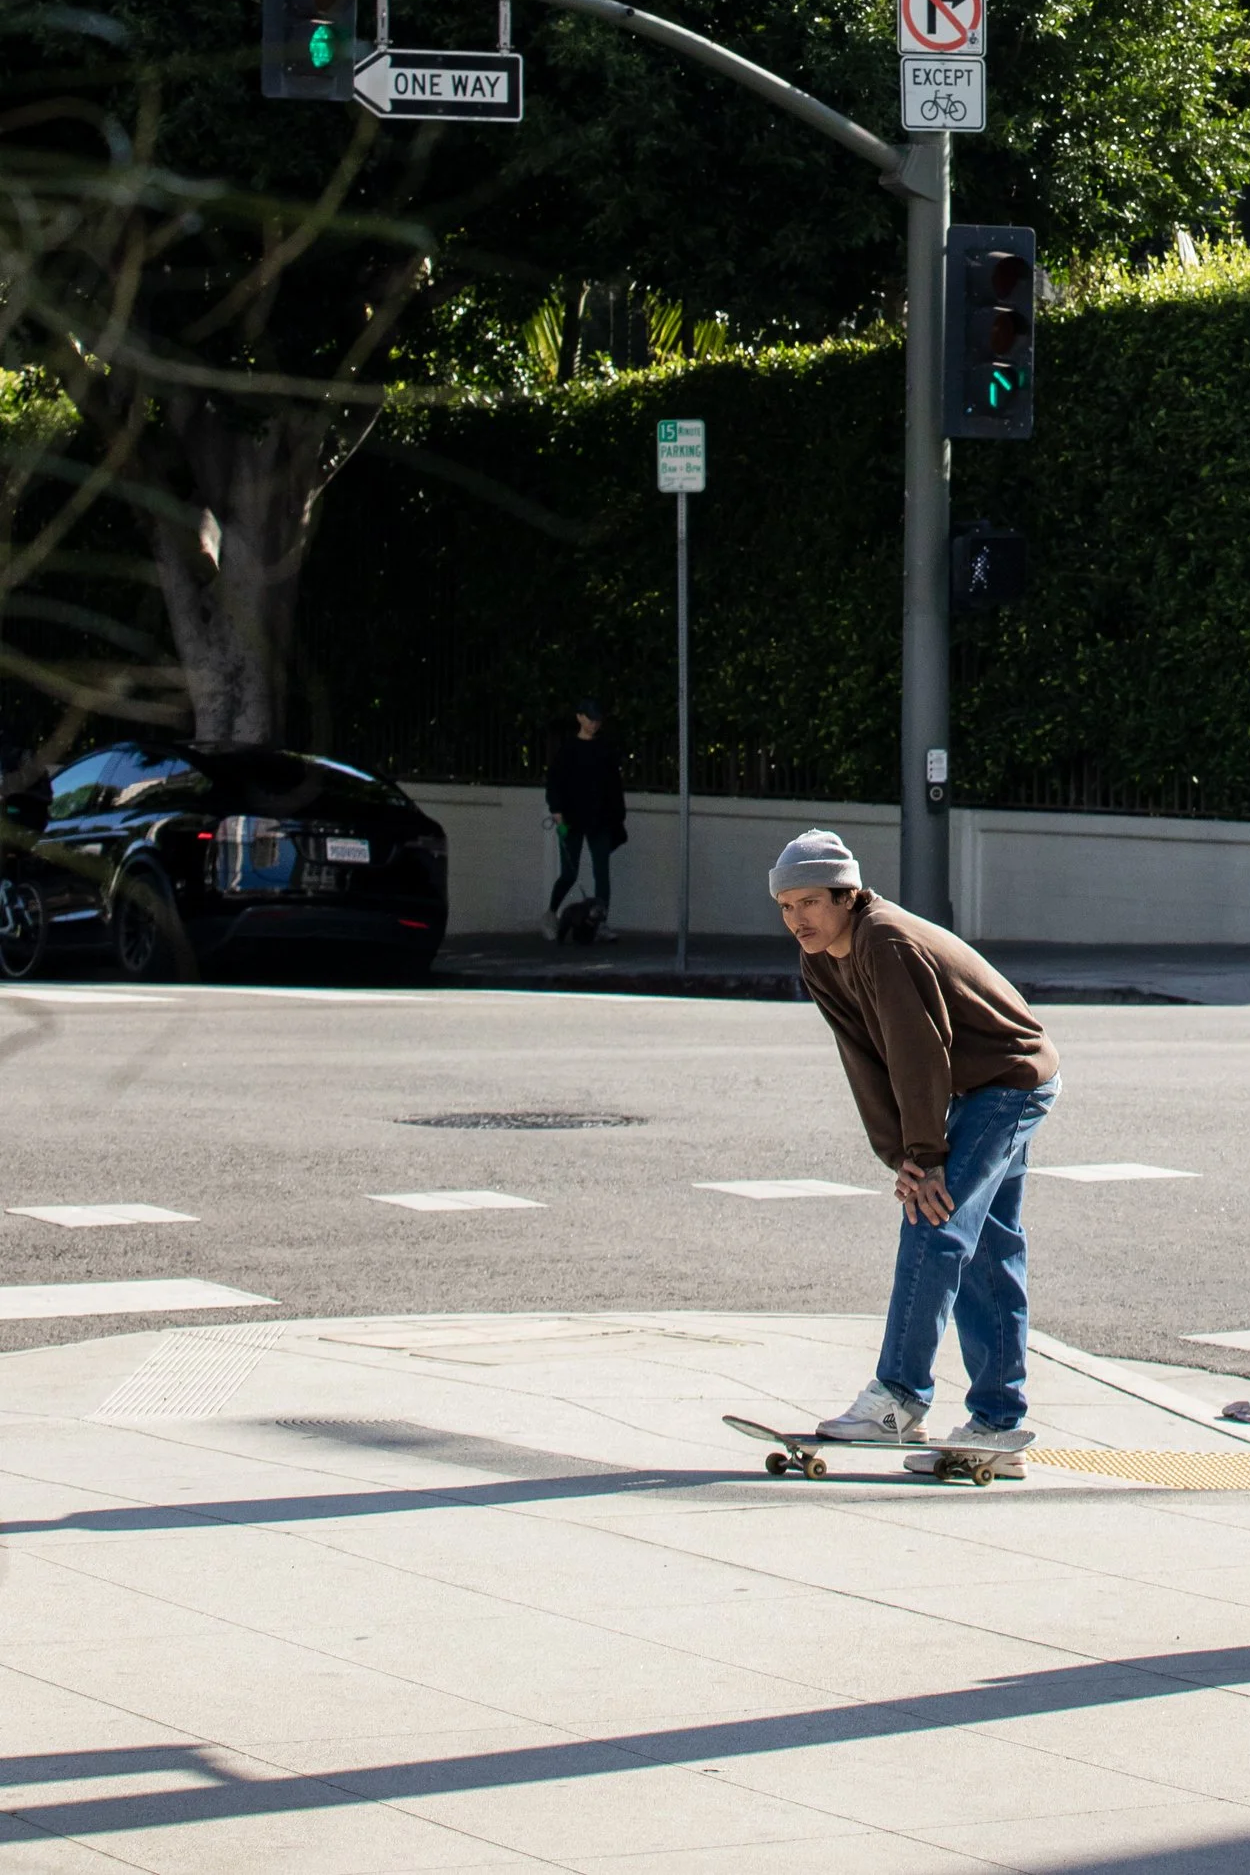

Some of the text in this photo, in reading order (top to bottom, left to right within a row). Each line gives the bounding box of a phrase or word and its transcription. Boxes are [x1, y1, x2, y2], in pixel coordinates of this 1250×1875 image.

[394, 72, 501, 98] ONE WAY
[912, 68, 973, 87] EXCEPT
[661, 425, 675, 439] 15
[660, 445, 701, 458] PARKING
